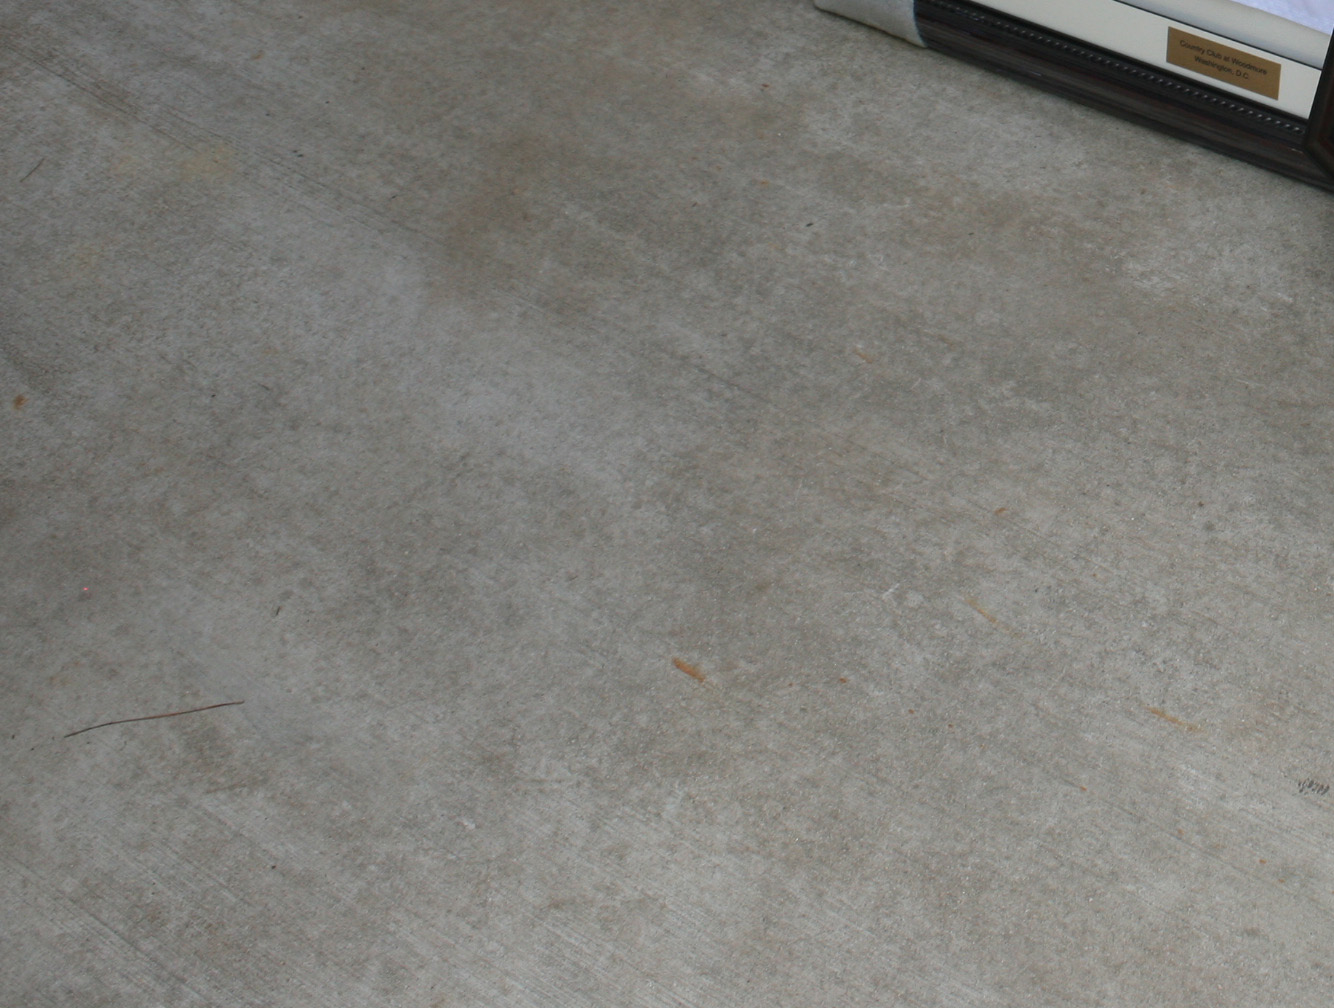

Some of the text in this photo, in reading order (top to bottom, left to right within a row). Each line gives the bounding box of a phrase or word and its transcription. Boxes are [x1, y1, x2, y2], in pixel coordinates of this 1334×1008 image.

[1179, 39, 1205, 55] Country
[1206, 48, 1222, 59] Club
[1231, 57, 1268, 75] Woodmore
